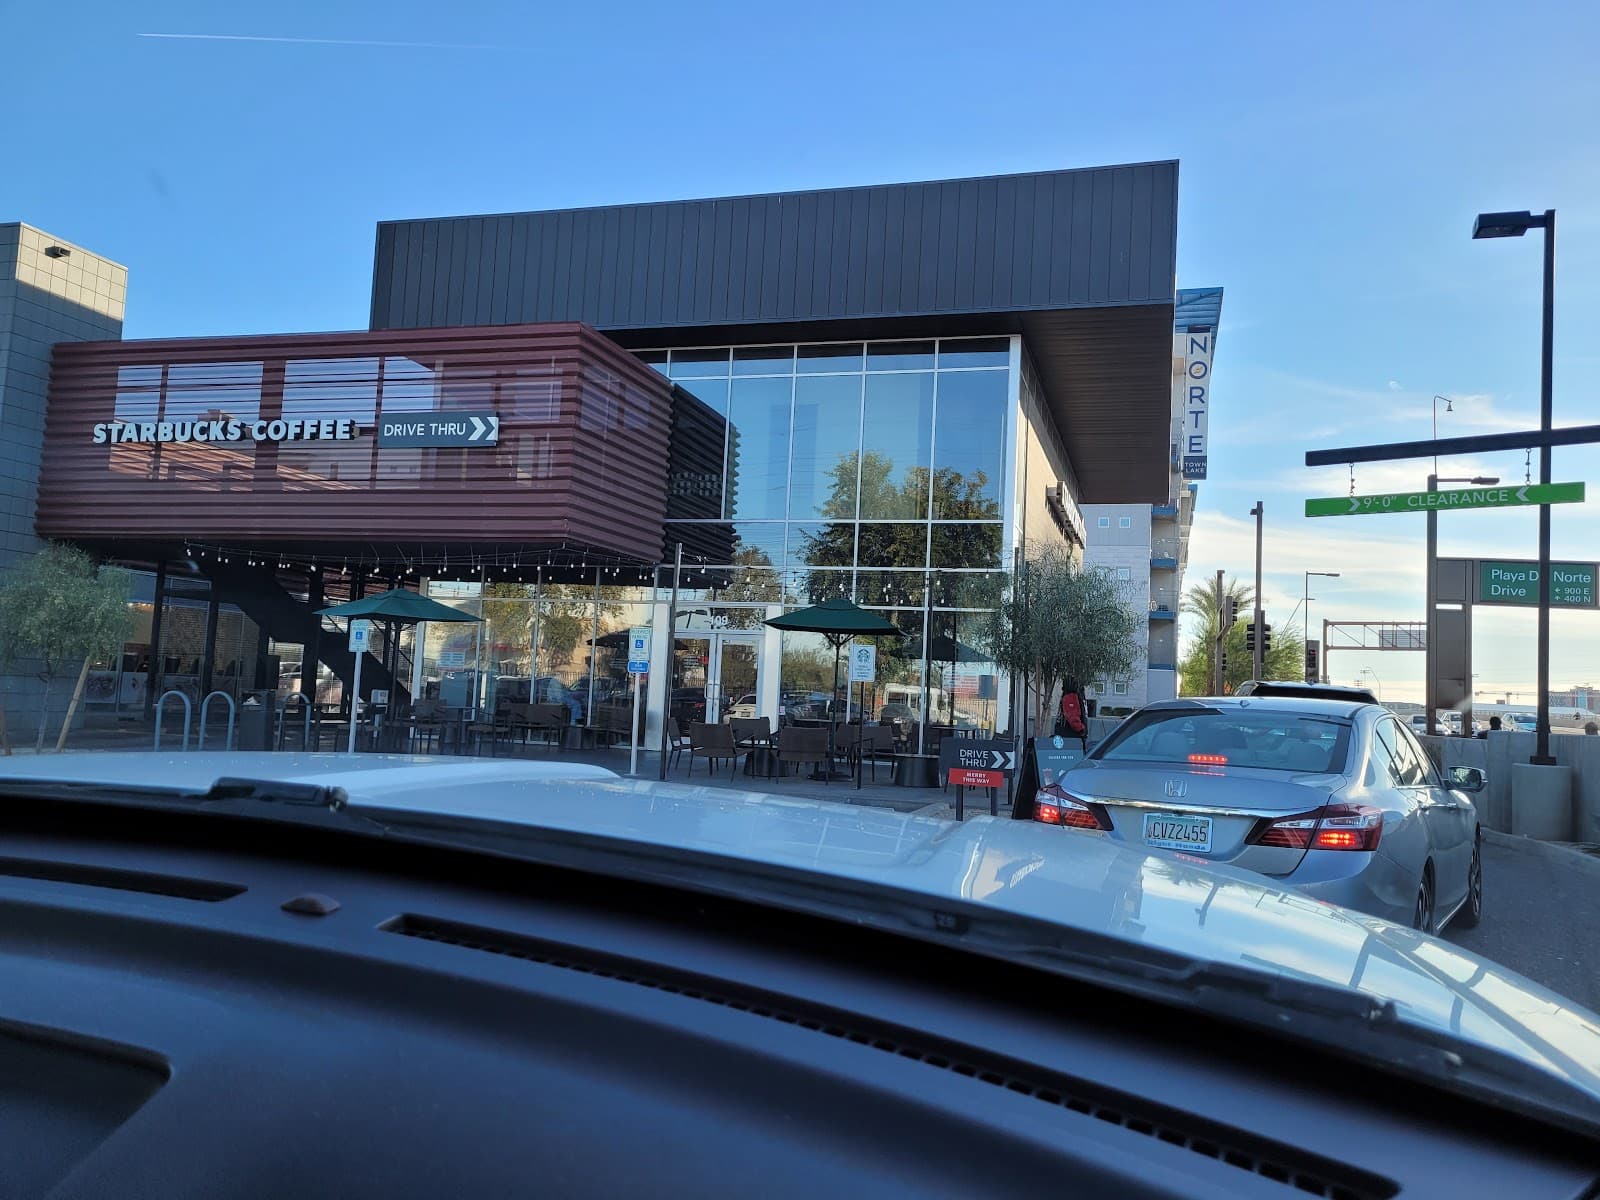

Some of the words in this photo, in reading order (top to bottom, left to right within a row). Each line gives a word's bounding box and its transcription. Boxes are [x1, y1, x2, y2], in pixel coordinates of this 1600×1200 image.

[1189, 336, 1207, 453] NORTE
[93, 420, 241, 443] STARBUCKS
[251, 419, 351, 441] COFFEE
[384, 423, 425, 436] DRIVE
[429, 422, 466, 435] THRU
[1408, 489, 1508, 507] CLEARANCE
[1491, 569, 1526, 582] Playa
[1553, 571, 1591, 583] Norte
[1491, 584, 1527, 596] Drive
[1564, 587, 1581, 595] 900
[710, 615, 728, 626] 109
[960, 749, 989, 759] DRIVE
[960, 758, 987, 768] THRU
[1153, 821, 1207, 842] CVZ2455
